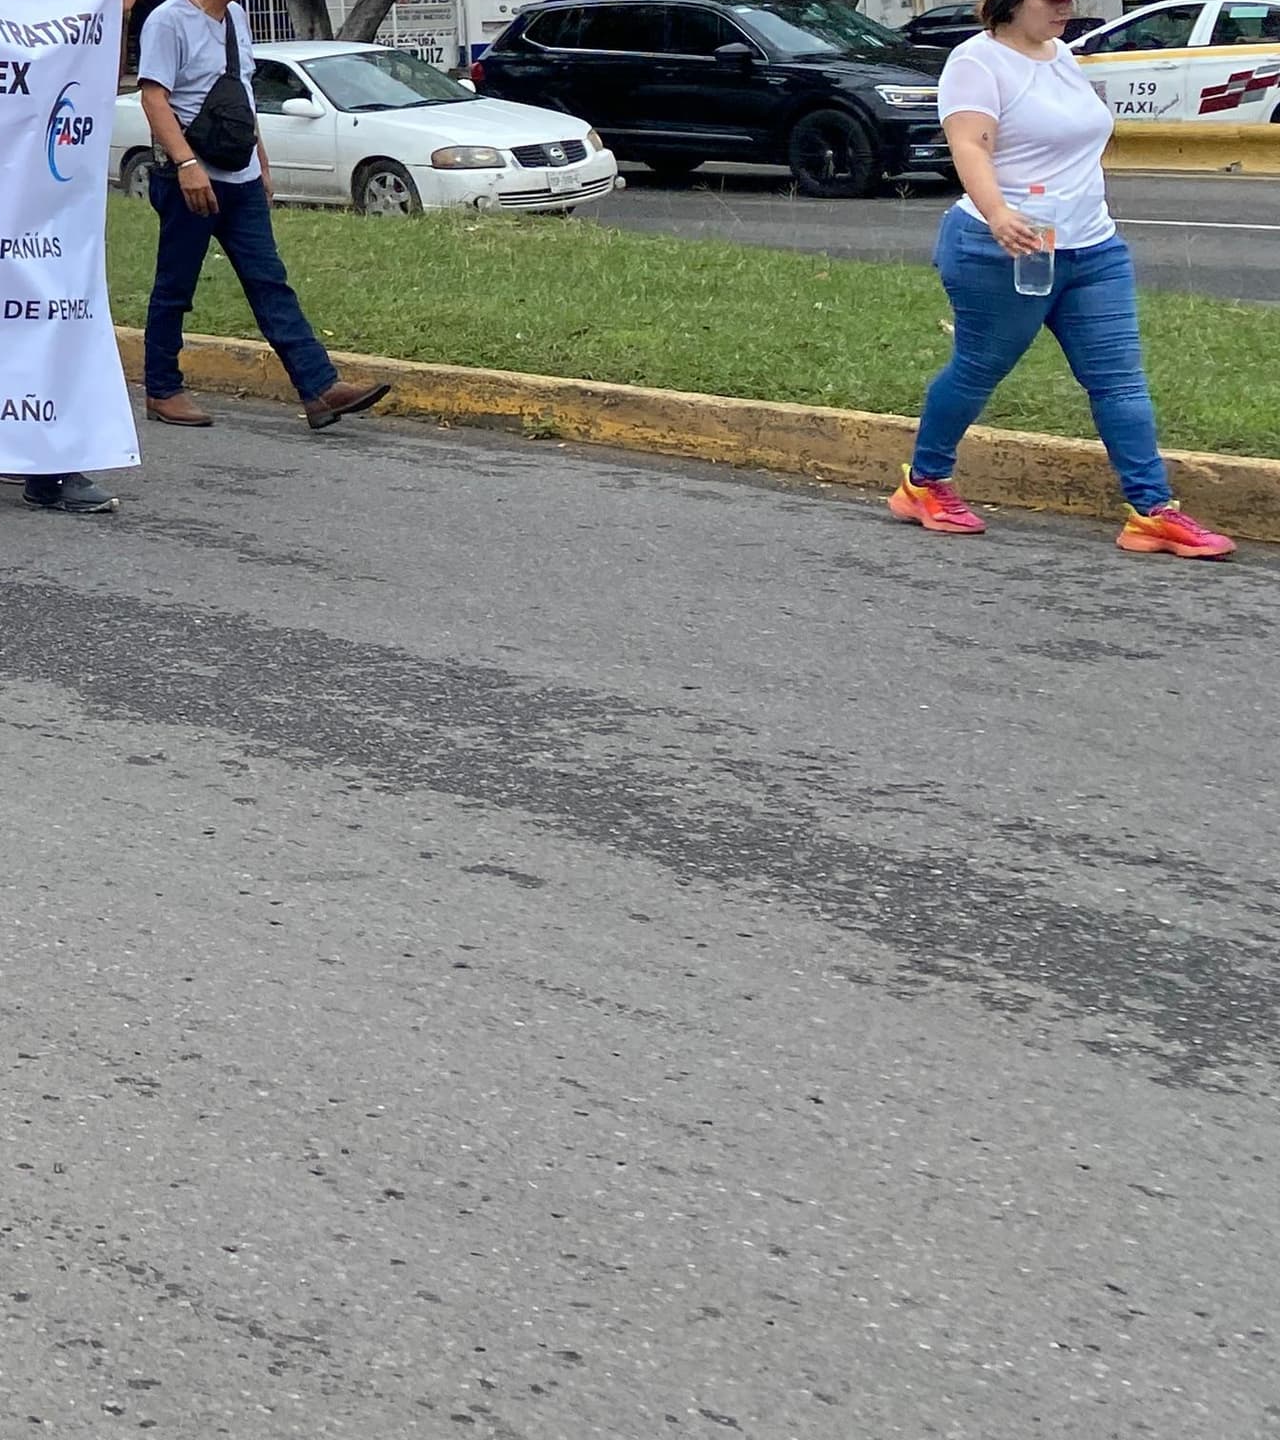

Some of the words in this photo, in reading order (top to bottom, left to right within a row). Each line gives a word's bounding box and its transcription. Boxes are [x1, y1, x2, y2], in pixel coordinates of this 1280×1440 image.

[1128, 82, 1157, 96] 159
[1114, 101, 1154, 114] TAXI
[46, 116, 93, 146] FASP
[4, 300, 41, 321] DE
[48, 298, 93, 321] PEMEX.
[0, 394, 57, 422] AÑO.
